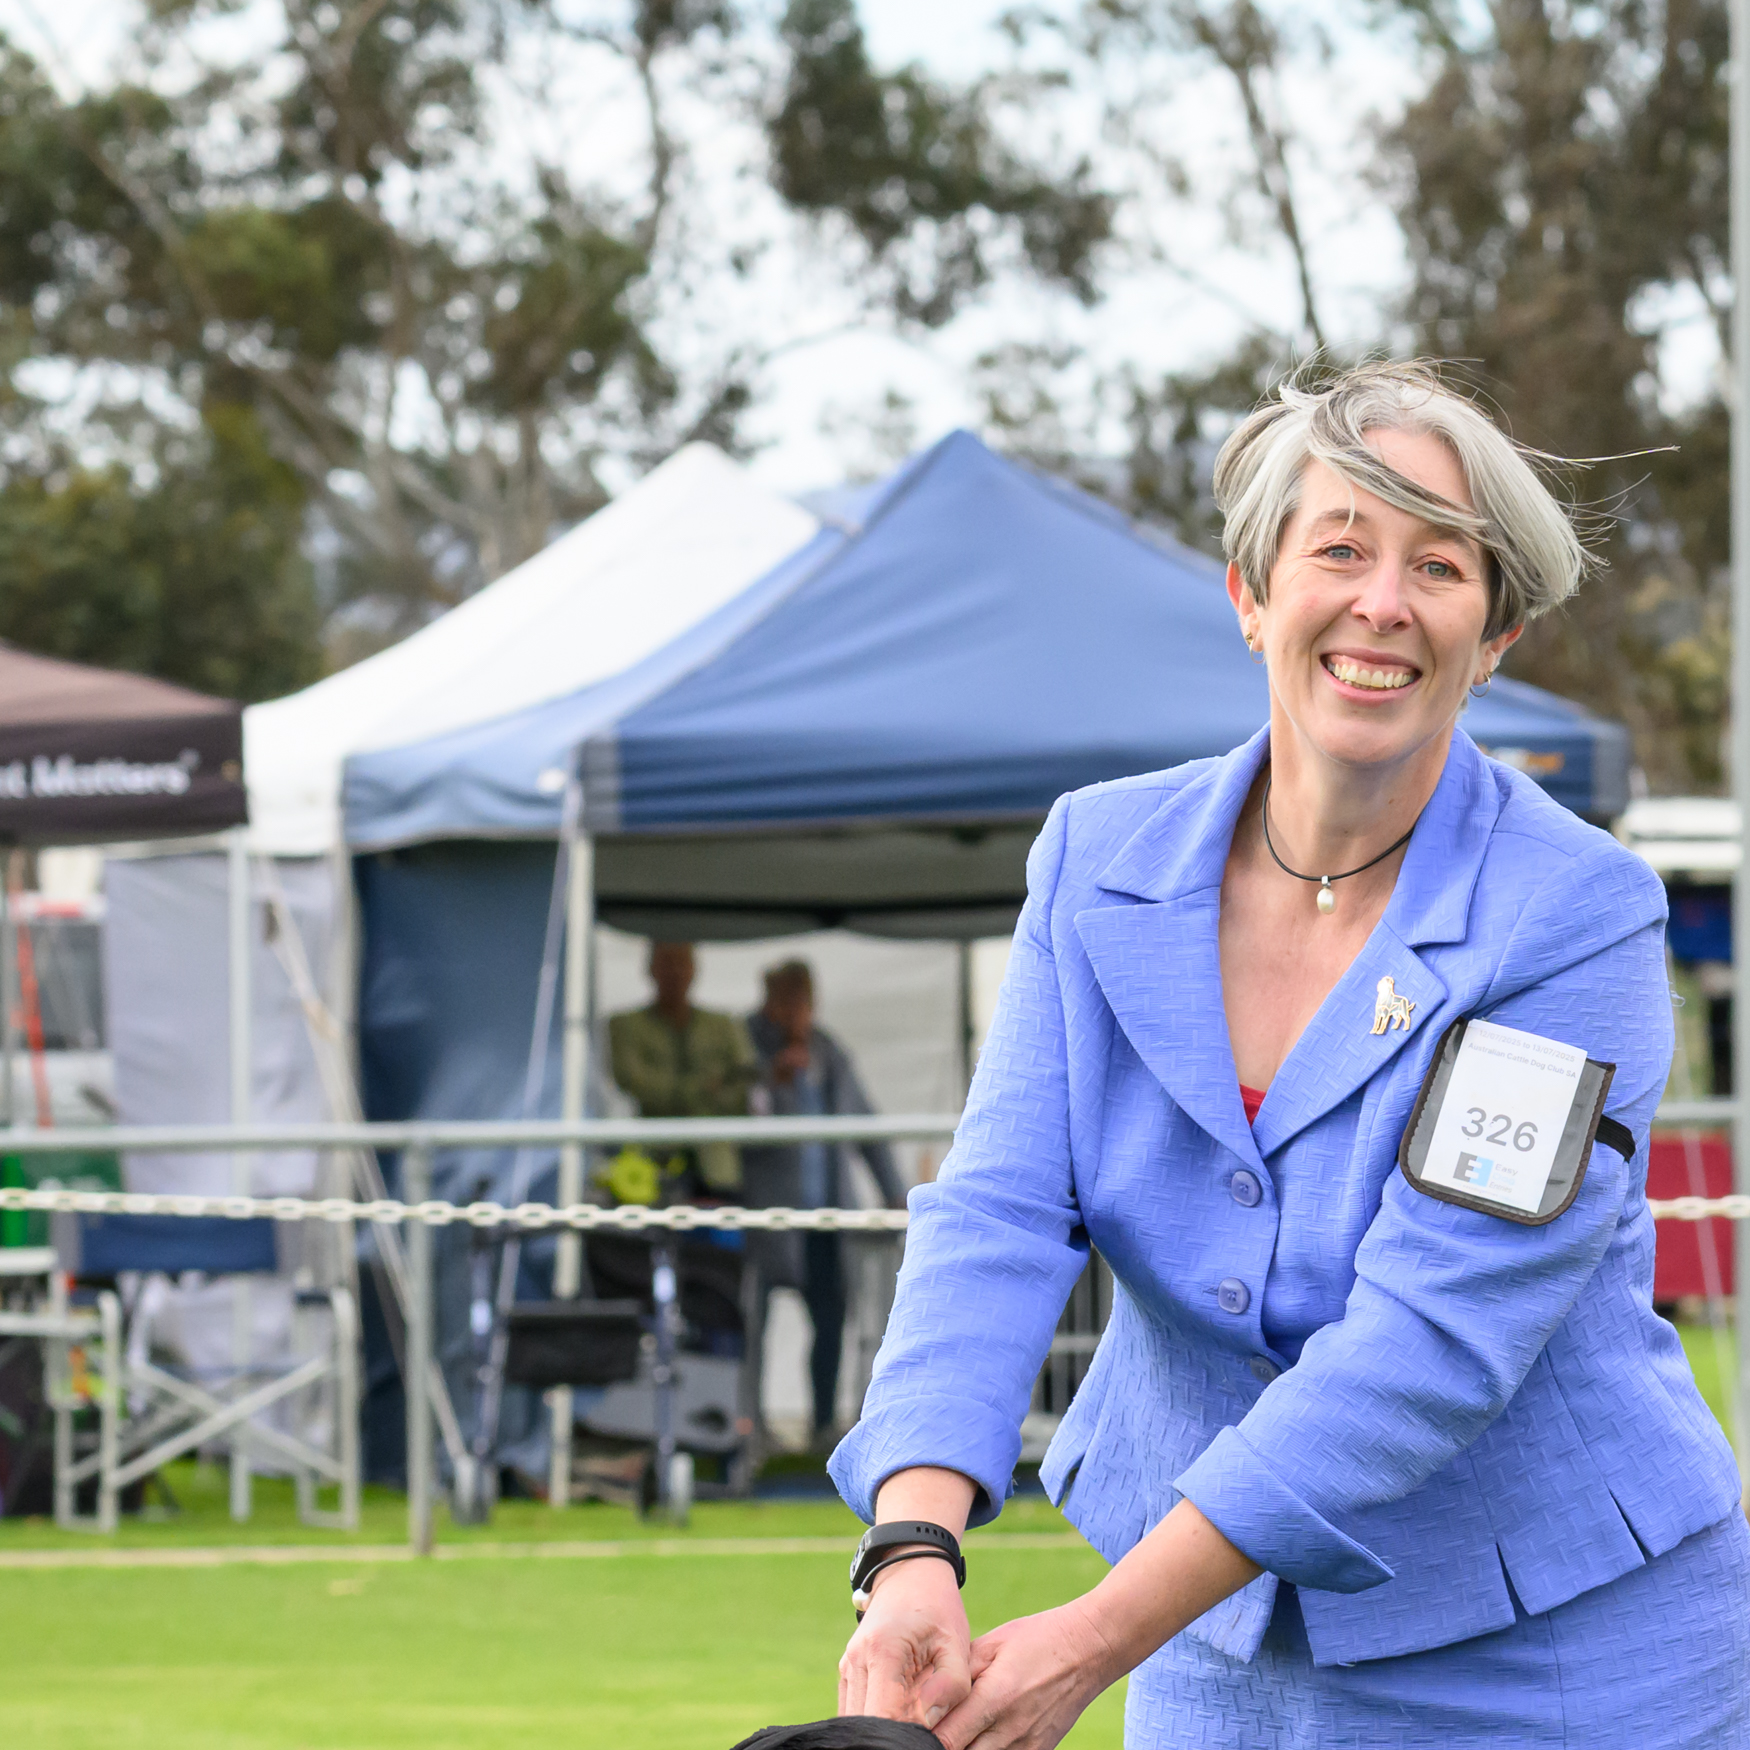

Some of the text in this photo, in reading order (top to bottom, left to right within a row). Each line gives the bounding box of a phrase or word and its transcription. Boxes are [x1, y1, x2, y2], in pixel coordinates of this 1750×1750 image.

[1467, 1042, 1577, 1079] Australian Cattle Dog Club SA
[1480, 1029, 1576, 1062] 12/07/2025 to 13/07/2025
[1461, 1106, 1539, 1152] 326
[1495, 1163, 1519, 1176] Easy
